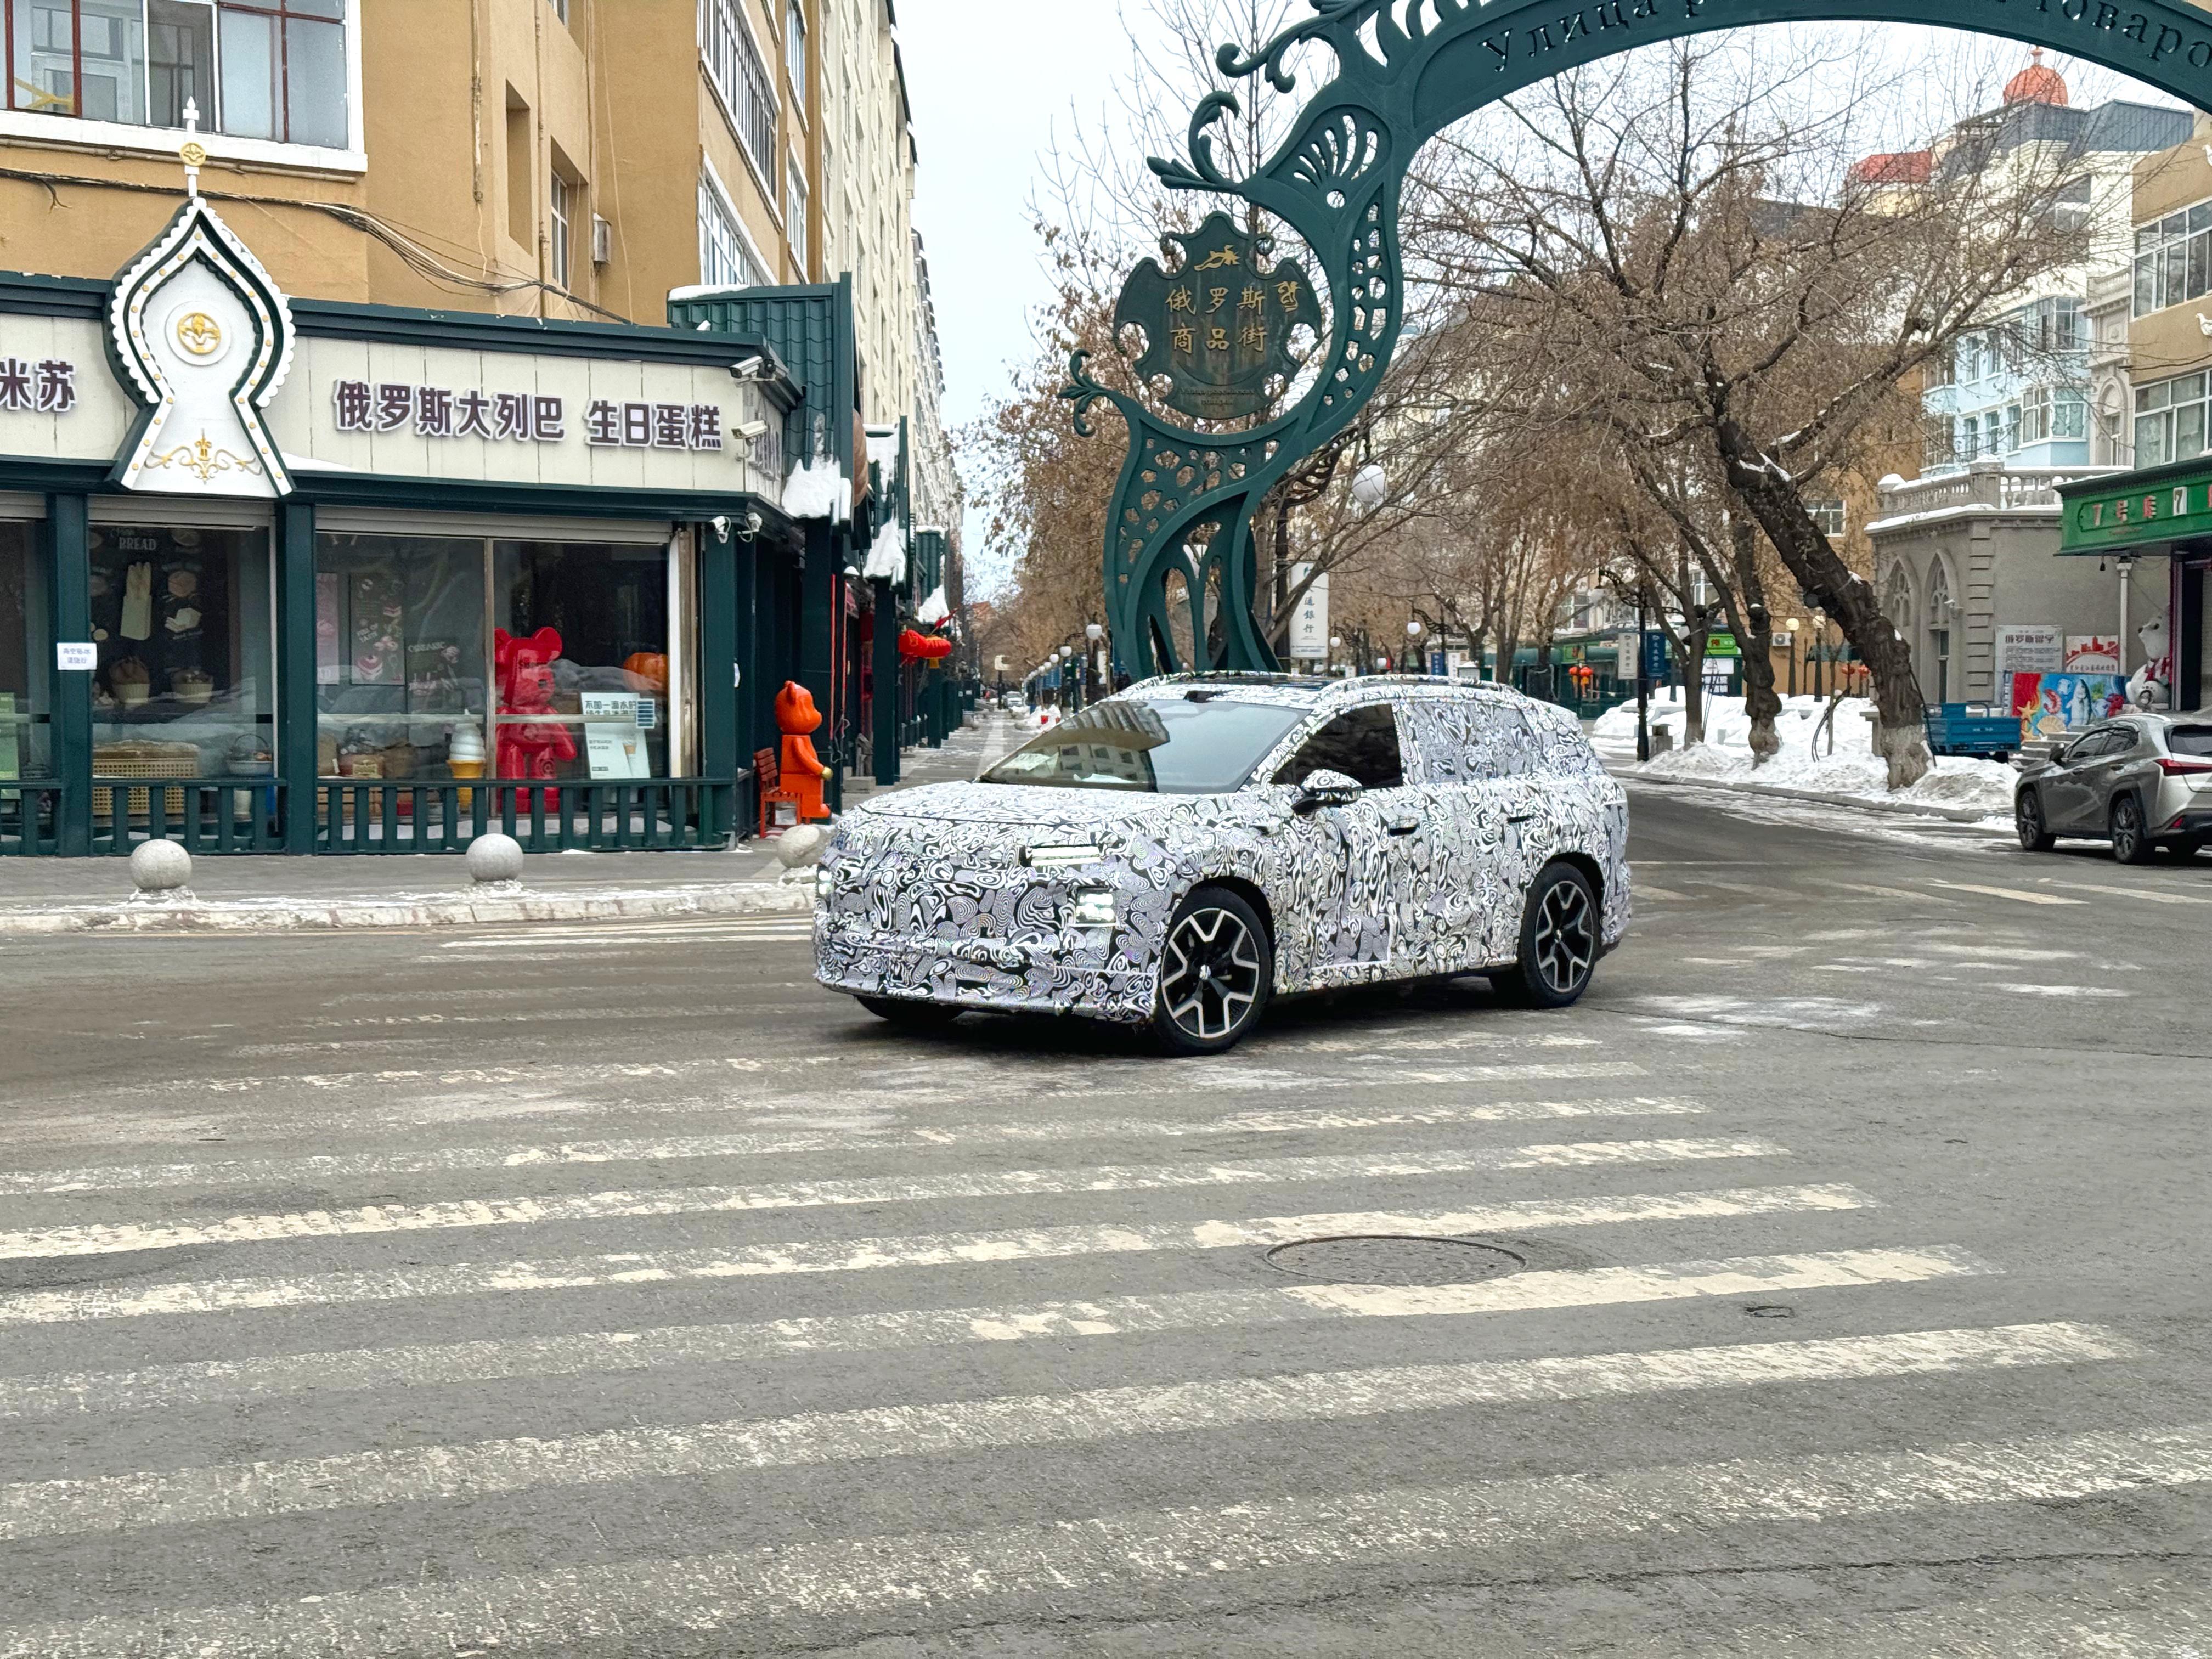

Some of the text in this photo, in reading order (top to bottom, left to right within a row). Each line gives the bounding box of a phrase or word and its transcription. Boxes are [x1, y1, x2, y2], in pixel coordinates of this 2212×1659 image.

[1165, 284, 1267, 316] 俄罗斯
[1170, 322, 1268, 355] 商品街
[0, 357, 76, 410] 米苏
[336, 380, 723, 450] 俄罗斯大列巴 生日蛋糕
[119, 537, 157, 550] BREAD
[1303, 589, 1315, 633] 通銀行
